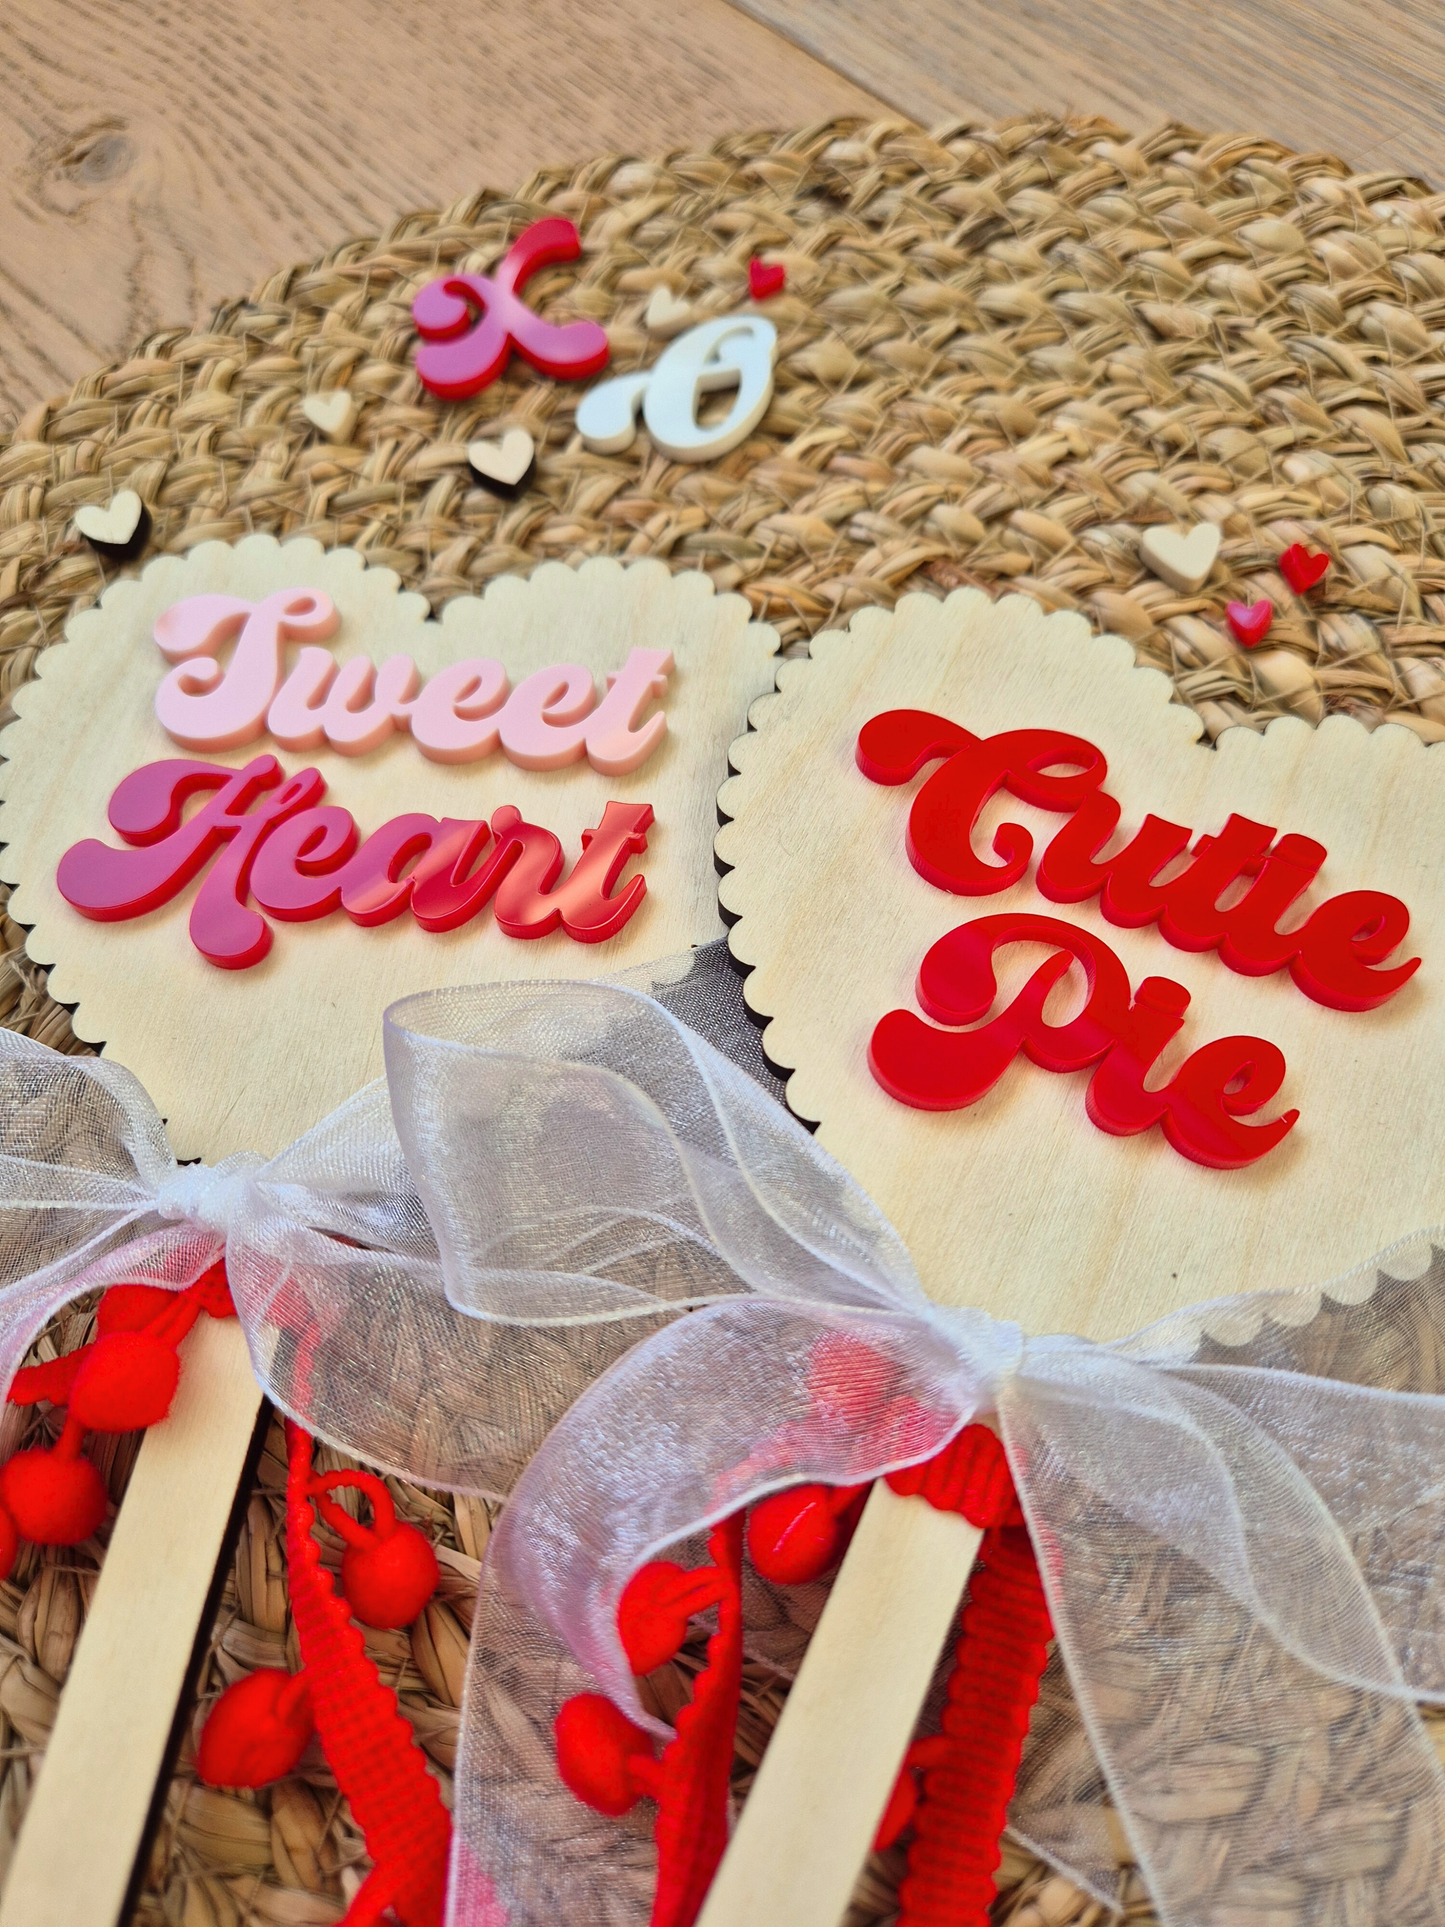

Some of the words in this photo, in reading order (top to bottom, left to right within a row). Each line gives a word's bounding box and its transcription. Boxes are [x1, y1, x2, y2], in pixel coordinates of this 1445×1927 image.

[153, 588, 676, 776] Sweet
[57, 753, 656, 969] Heart
[856, 708, 1422, 1012] Cutie
[868, 912, 1300, 1169] Pie
